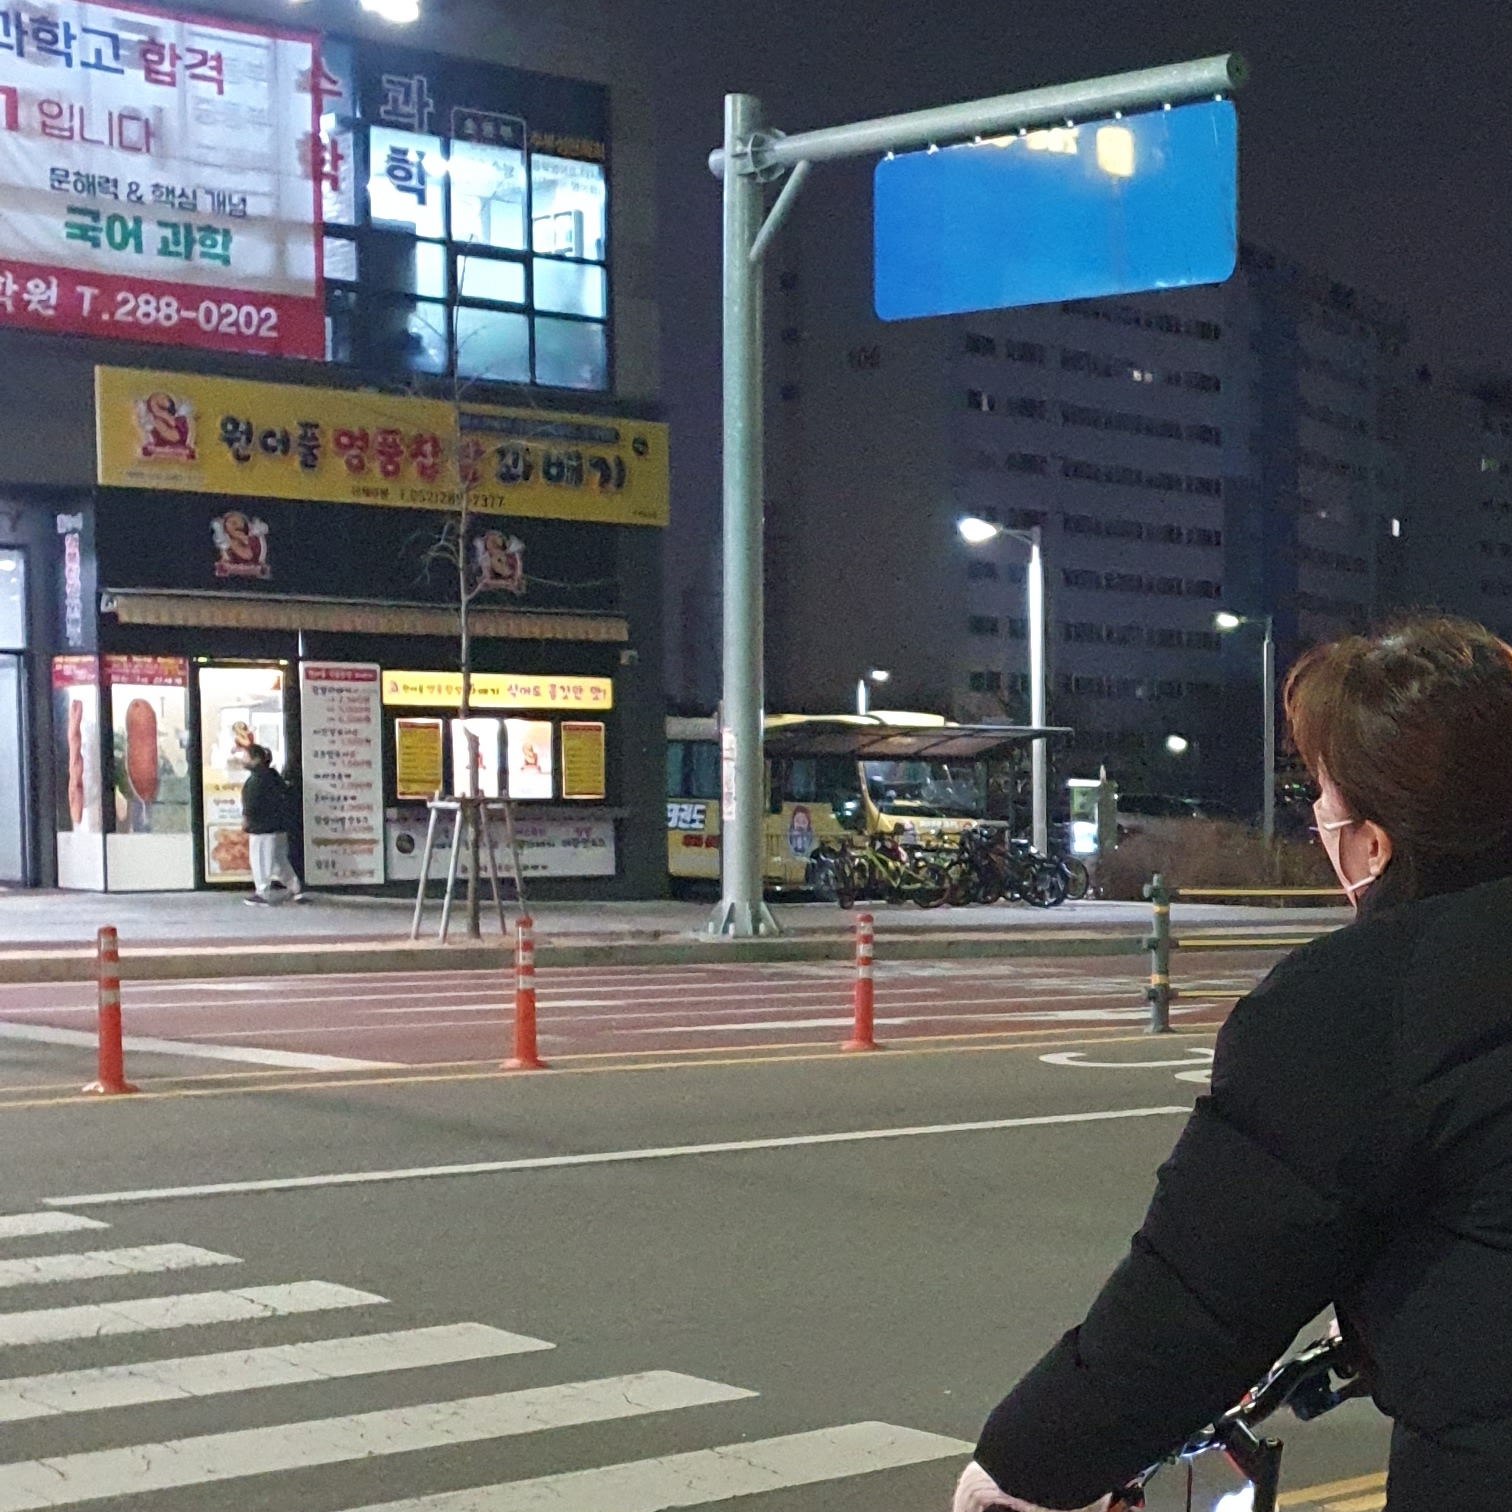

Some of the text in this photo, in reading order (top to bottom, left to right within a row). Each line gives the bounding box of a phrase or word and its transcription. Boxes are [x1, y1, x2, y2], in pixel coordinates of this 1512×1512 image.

[140, 38, 225, 95] 합격
[37, 98, 157, 153] 입니다
[50, 166, 247, 218] 문해력 & 핵심 개념
[64, 204, 233, 267] 국어 과학
